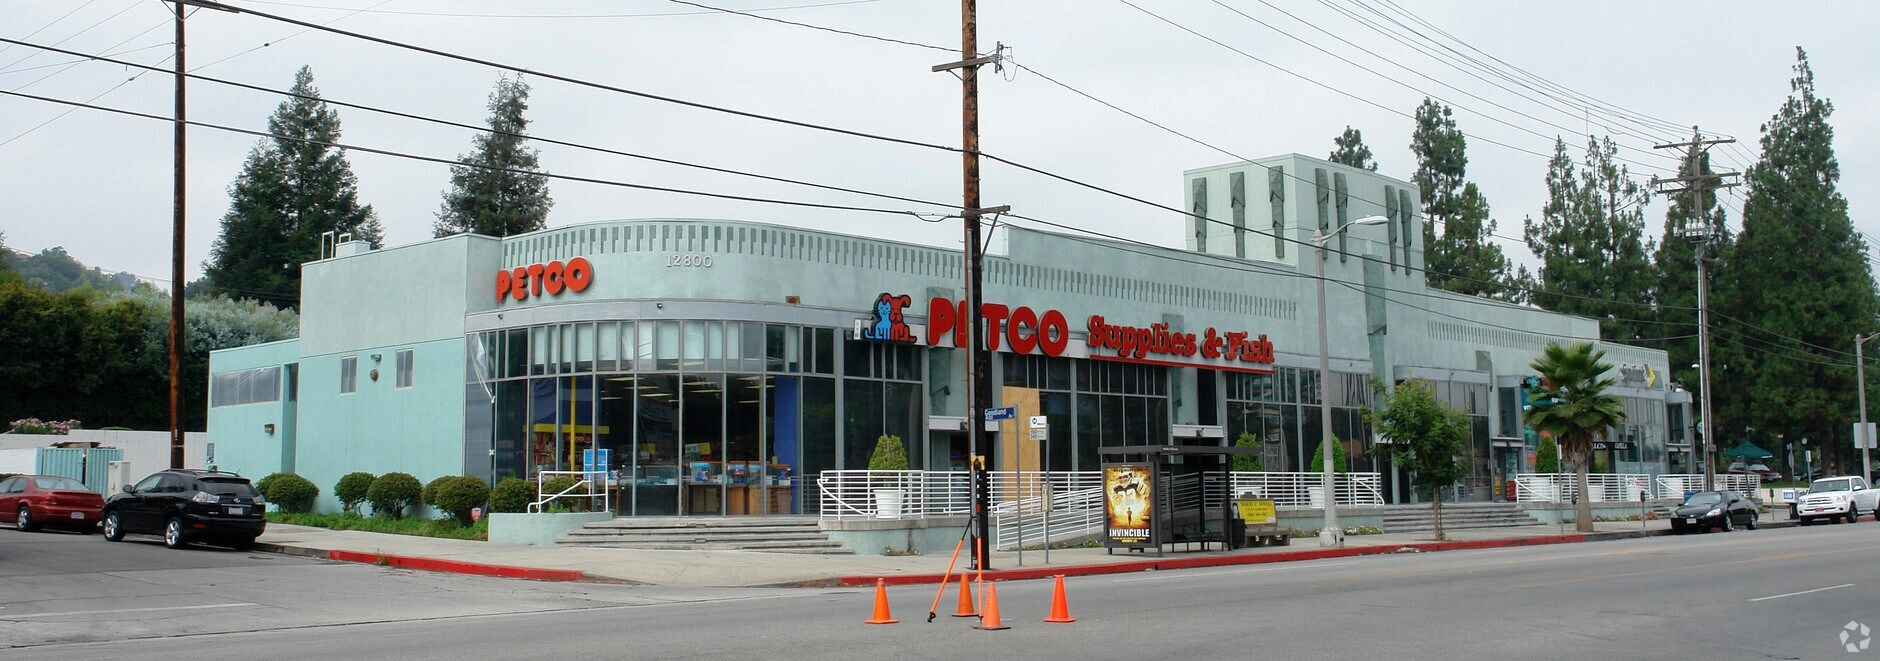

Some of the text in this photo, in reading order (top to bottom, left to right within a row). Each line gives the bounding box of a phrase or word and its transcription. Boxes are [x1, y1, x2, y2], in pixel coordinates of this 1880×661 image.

[666, 255, 713, 268] 12800
[496, 257, 594, 303] PETCO
[1087, 314, 1197, 358] Supplies
[1200, 327, 1223, 358] &
[1224, 331, 1275, 364] Fish
[1109, 528, 1150, 537] INVINCIBLE
